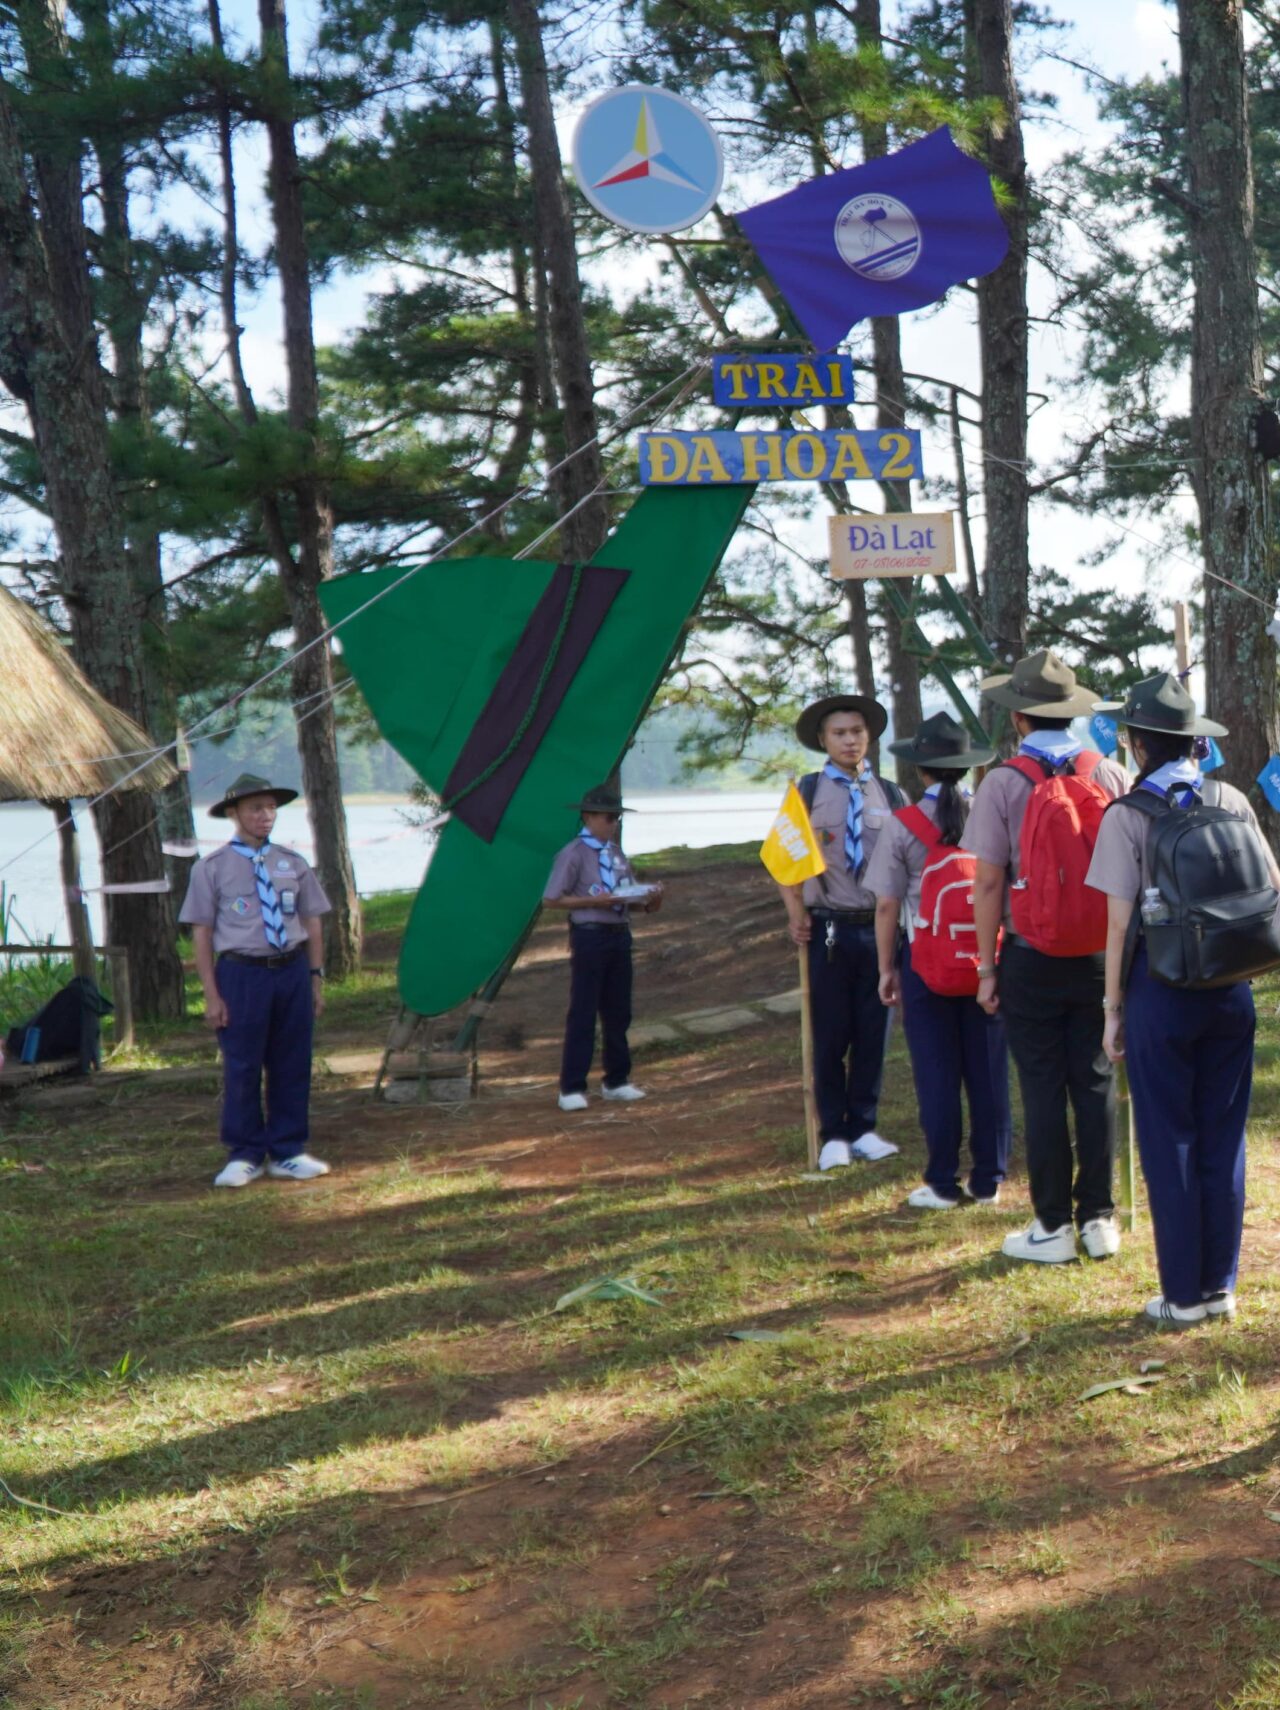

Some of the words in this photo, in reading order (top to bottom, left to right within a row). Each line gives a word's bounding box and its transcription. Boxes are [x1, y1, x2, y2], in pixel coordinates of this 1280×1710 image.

[645, 436, 732, 483] ĐA
[878, 433, 915, 479] 2
[848, 525, 886, 552] Đà
[892, 524, 937, 556] Lạt
